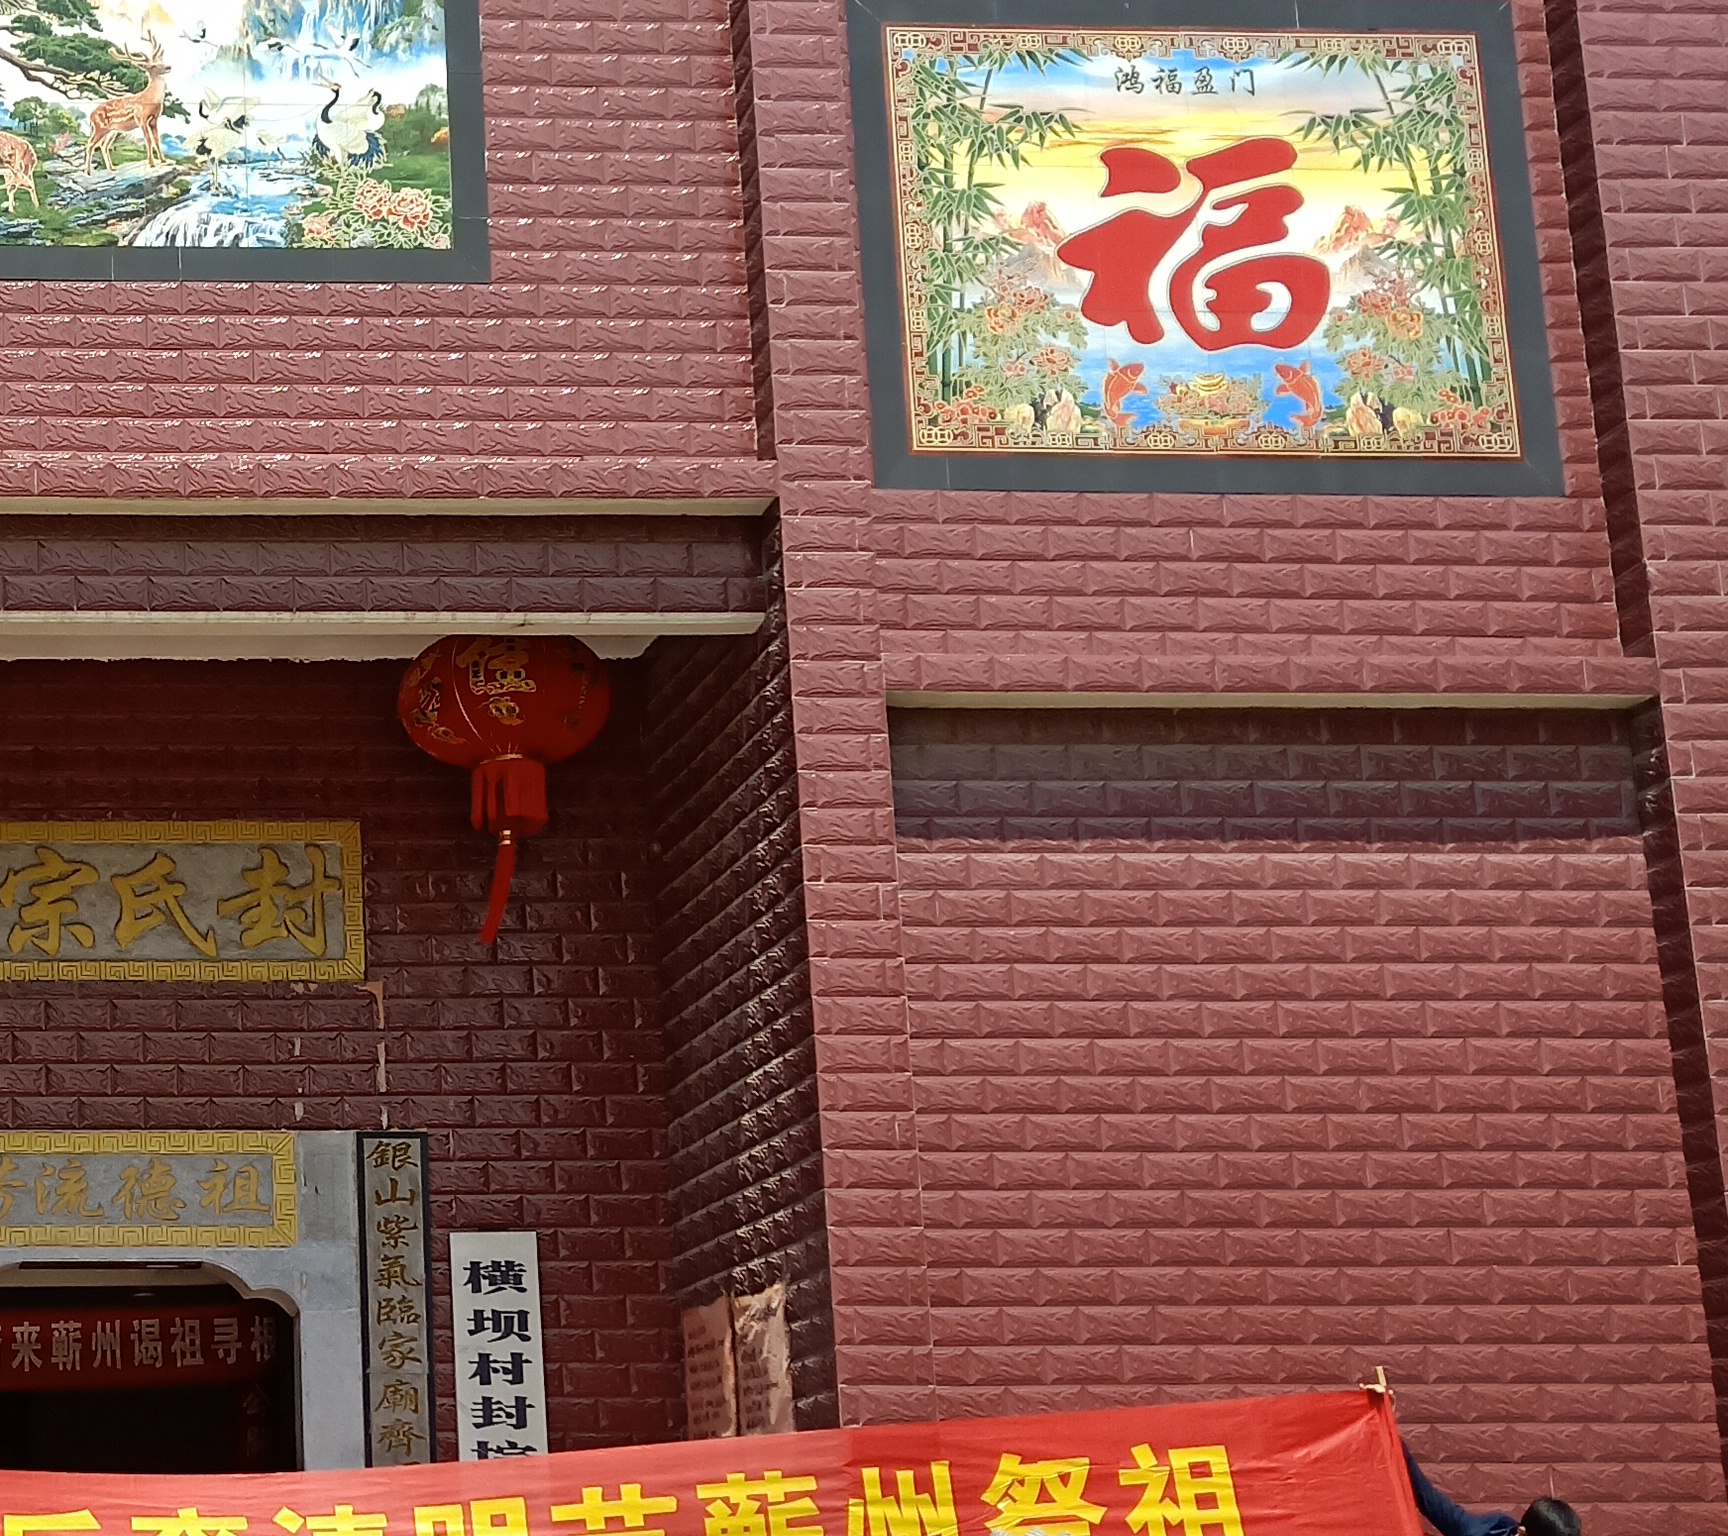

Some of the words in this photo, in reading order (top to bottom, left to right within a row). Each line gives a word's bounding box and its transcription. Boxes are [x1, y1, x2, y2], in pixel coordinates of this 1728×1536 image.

[1114, 64, 1256, 97] 鸿福盈门
[1057, 136, 1331, 351] 福
[366, 1140, 427, 1464] 銀山紫氣臨家廟齊
